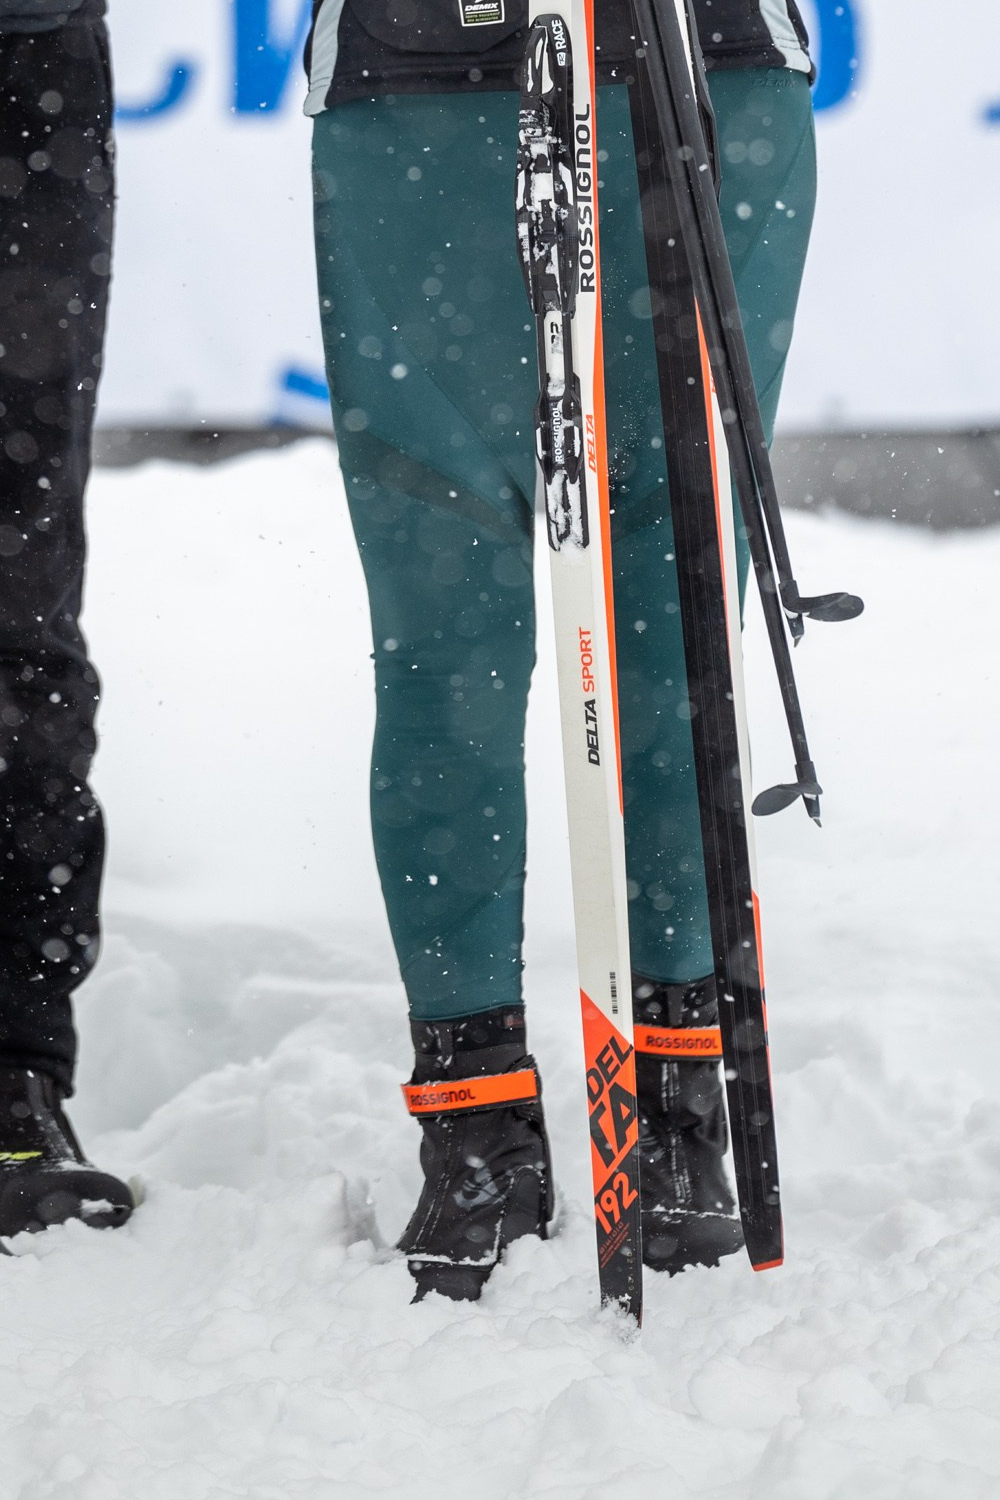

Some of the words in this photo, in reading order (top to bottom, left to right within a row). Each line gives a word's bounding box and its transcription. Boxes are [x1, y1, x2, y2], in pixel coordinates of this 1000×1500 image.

[464, 2, 499, 12] DEMIX
[551, 18, 567, 50] RACE
[585, 413, 597, 473] DELTA
[578, 626, 595, 693] SPORT
[584, 698, 601, 767] DELTA
[595, 1171, 639, 1234] 192
